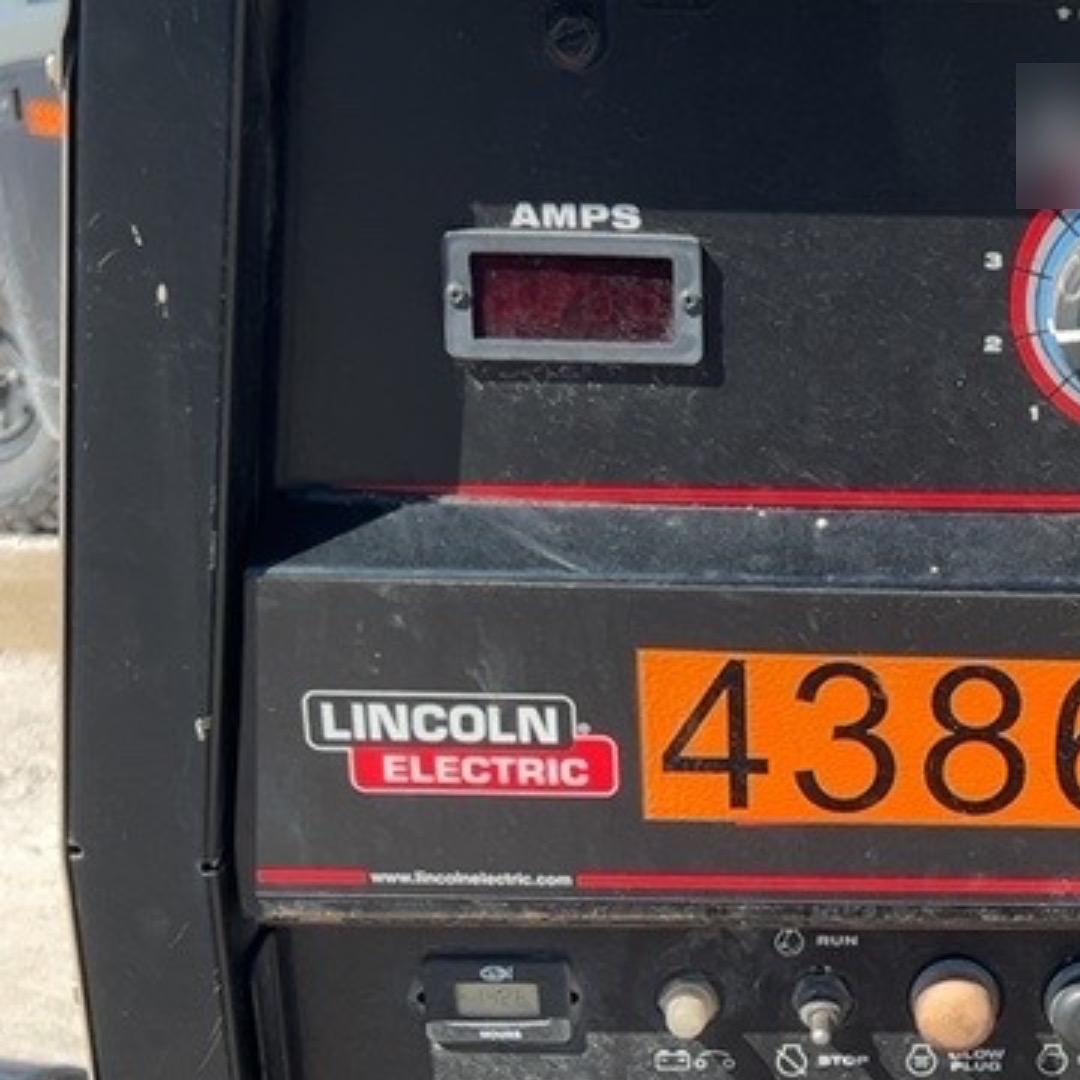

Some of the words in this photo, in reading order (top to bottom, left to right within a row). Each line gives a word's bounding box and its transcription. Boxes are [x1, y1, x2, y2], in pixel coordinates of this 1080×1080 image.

[509, 203, 643, 231] AMPS
[984, 252, 1003, 270] 3
[984, 336, 1003, 353] 2
[1029, 406, 1040, 421] 1
[318, 701, 561, 745] LINCOLN
[382, 754, 589, 787] ELECTRIC
[369, 869, 573, 889] www.lincolnelectric.com
[816, 935, 858, 946] RUN
[818, 1055, 869, 1067] STOP
[950, 1061, 1002, 1072] PLUG
